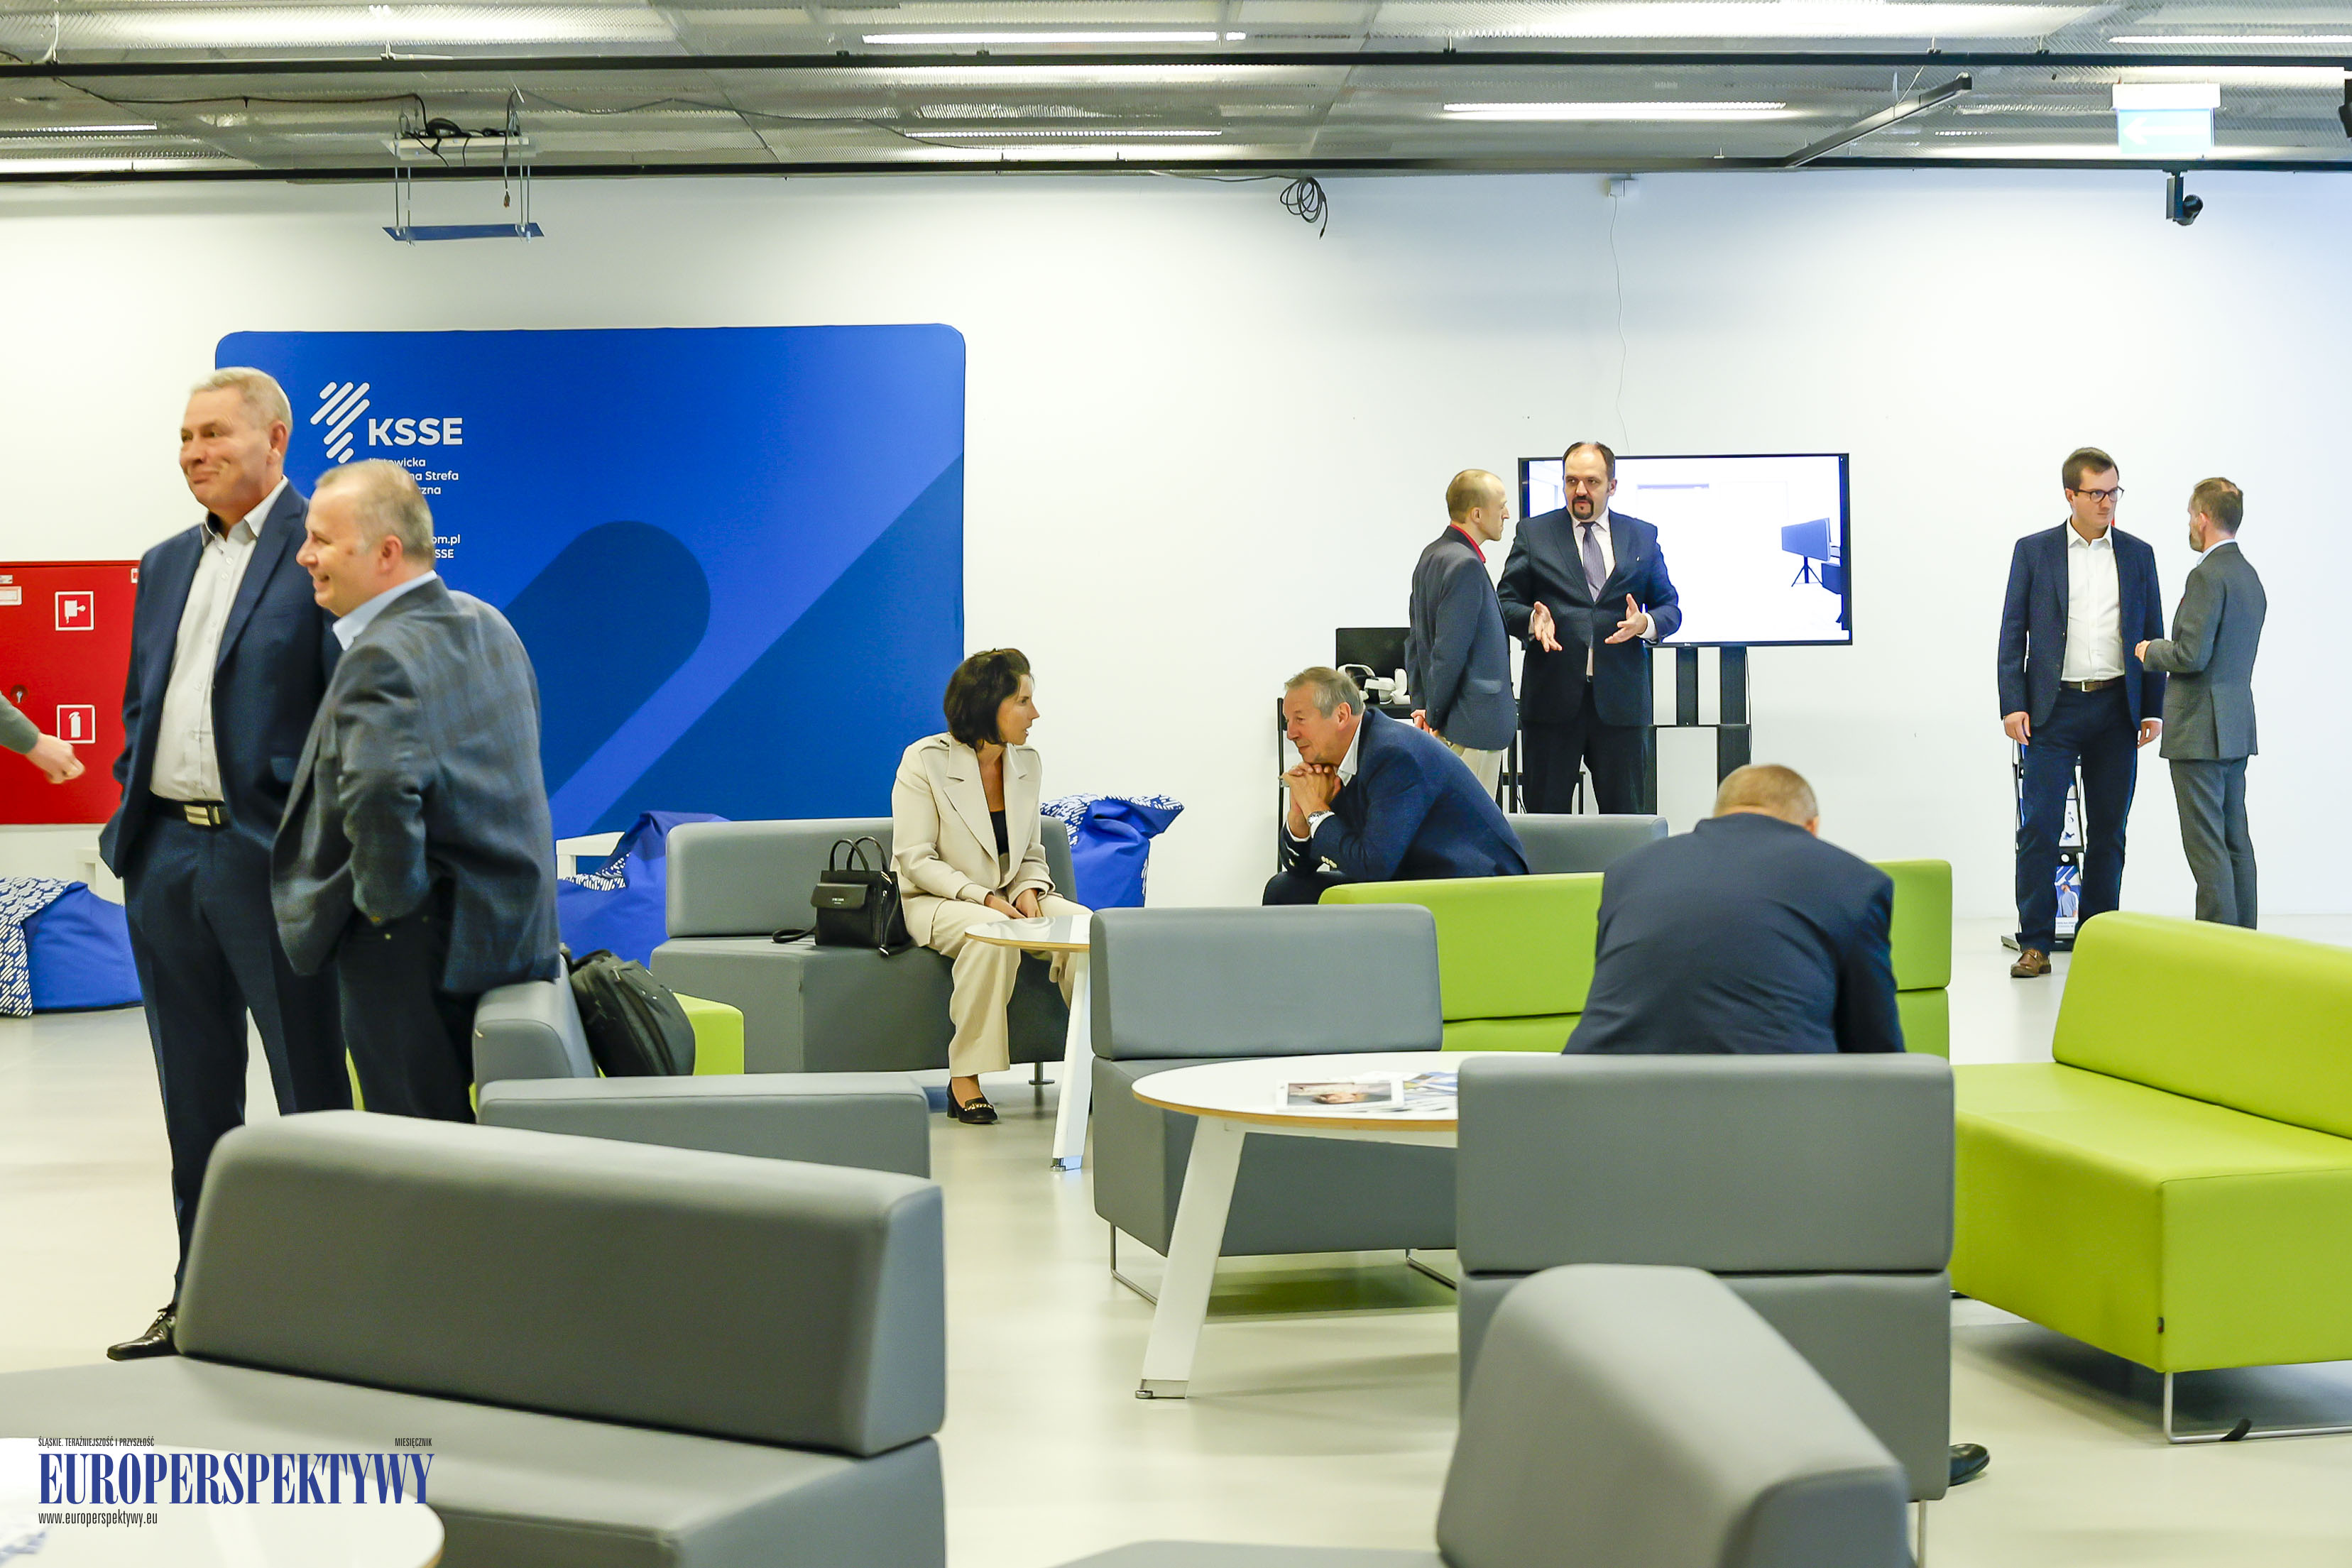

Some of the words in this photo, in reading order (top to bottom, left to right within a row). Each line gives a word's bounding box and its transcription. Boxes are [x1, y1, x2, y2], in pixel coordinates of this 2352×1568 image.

[368, 417, 462, 446] KSSE
[425, 470, 459, 481] Strefa
[432, 534, 461, 546] om.pl
[434, 549, 454, 559] SSE
